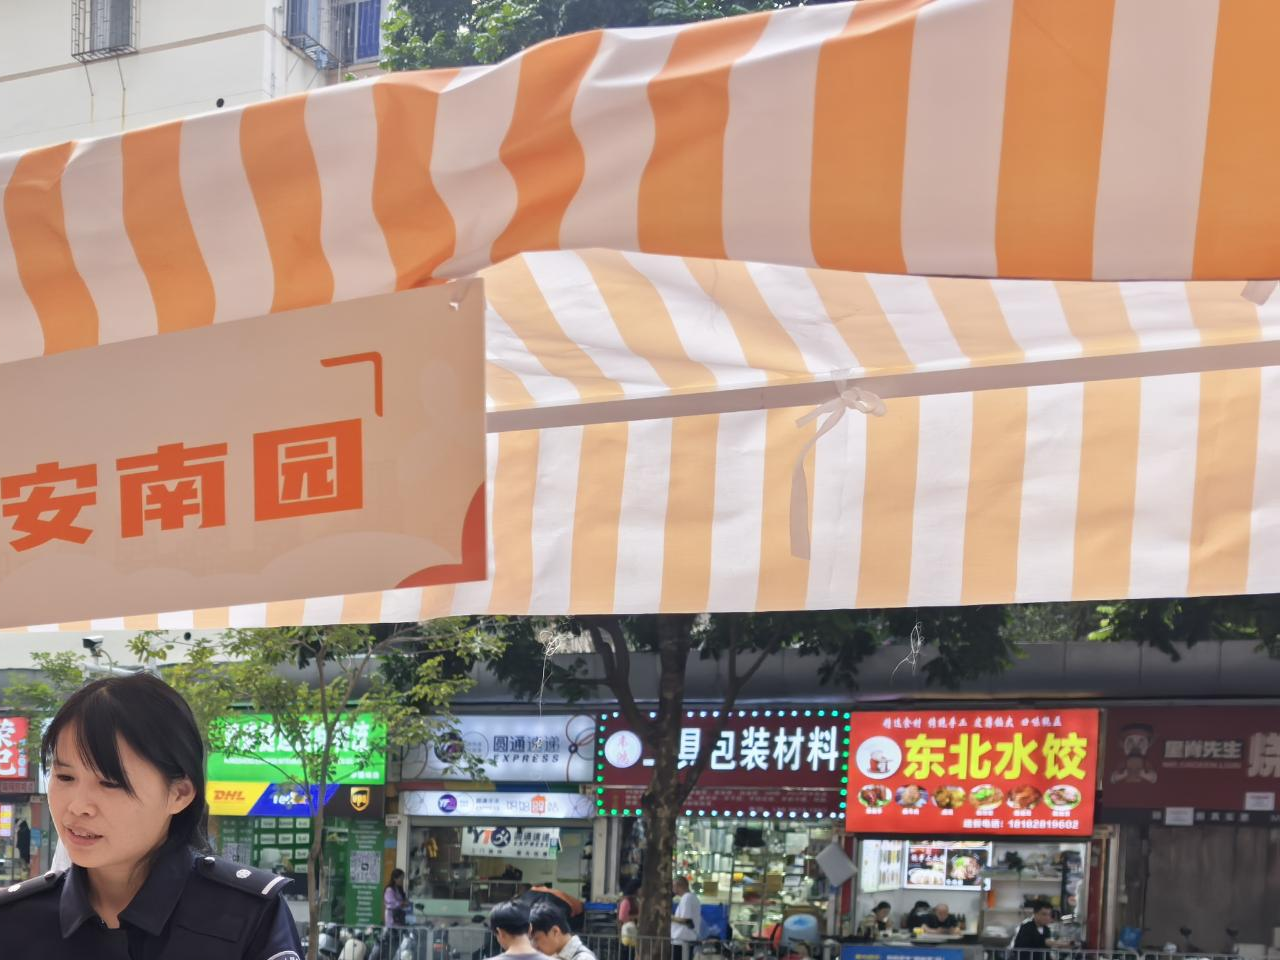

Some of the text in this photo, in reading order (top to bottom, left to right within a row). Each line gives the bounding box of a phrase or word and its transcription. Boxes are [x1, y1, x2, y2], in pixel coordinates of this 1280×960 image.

[493, 754, 560, 763] EXPRESS
[643, 726, 839, 771] 具包装材料
[903, 732, 1088, 780] 东北水饺
[214, 790, 246, 801] DHL
